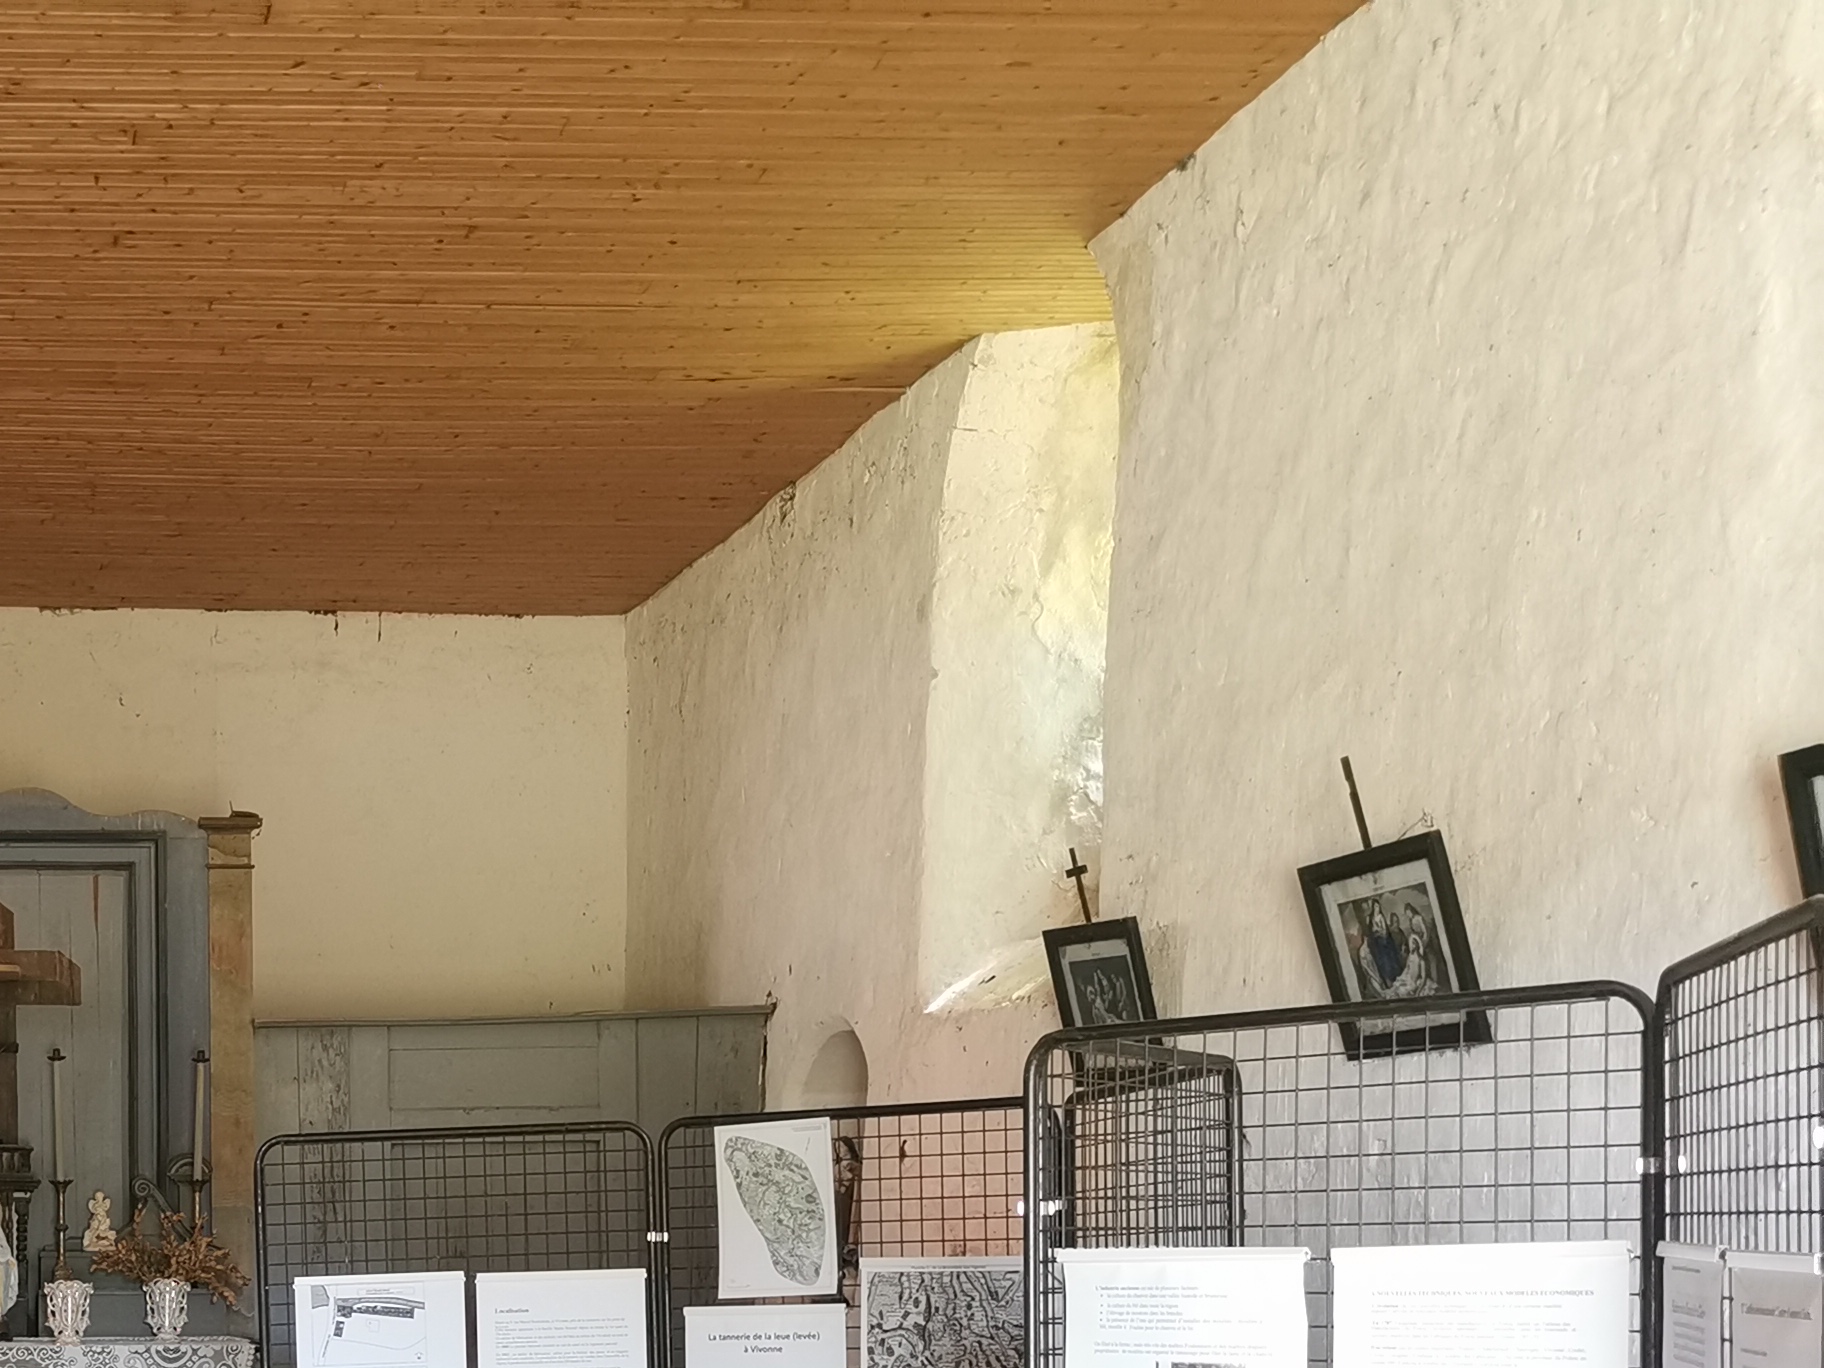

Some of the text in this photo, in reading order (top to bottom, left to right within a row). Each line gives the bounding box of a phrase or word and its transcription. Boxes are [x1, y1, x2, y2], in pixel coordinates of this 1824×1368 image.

[719, 1333, 751, 1341] tannerie
[752, 1333, 762, 1341] de
[764, 1332, 772, 1340] la
[774, 1332, 790, 1340] leue
[792, 1331, 820, 1341] (levée)
[750, 1345, 783, 1353] Vivonne
